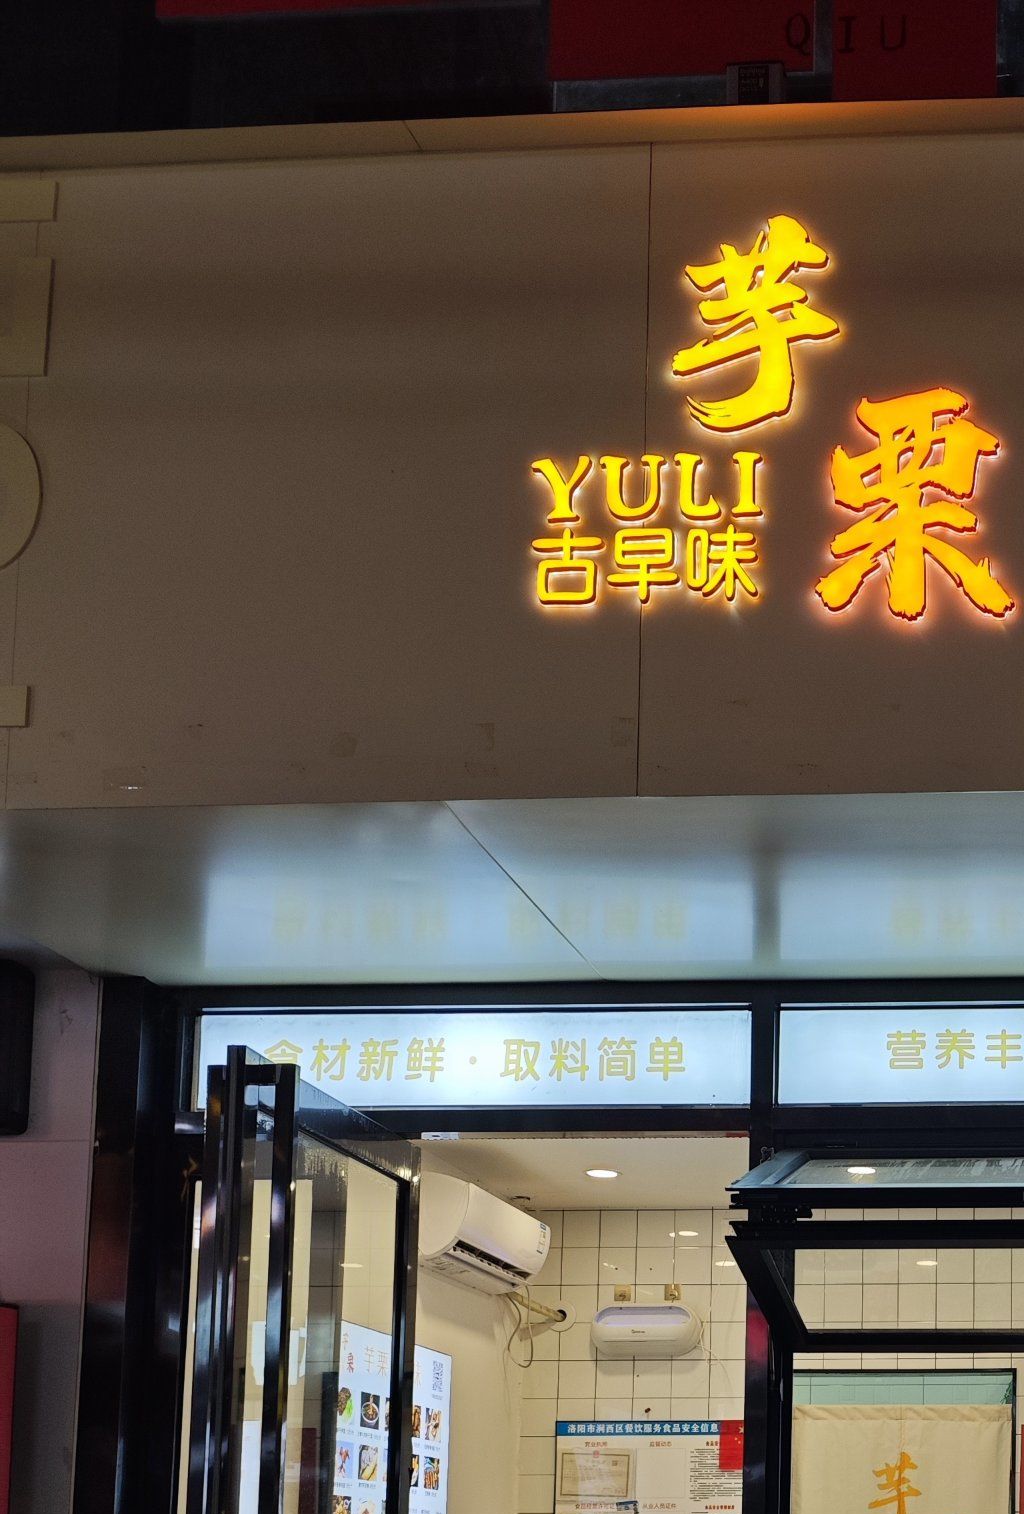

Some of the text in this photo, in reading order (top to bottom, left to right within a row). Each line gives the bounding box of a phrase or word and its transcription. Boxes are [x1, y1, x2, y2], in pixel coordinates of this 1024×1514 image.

[671, 214, 840, 433] 芋
[532, 451, 764, 523] YULI
[815, 387, 1015, 621] 栗
[532, 526, 759, 606] 古早味
